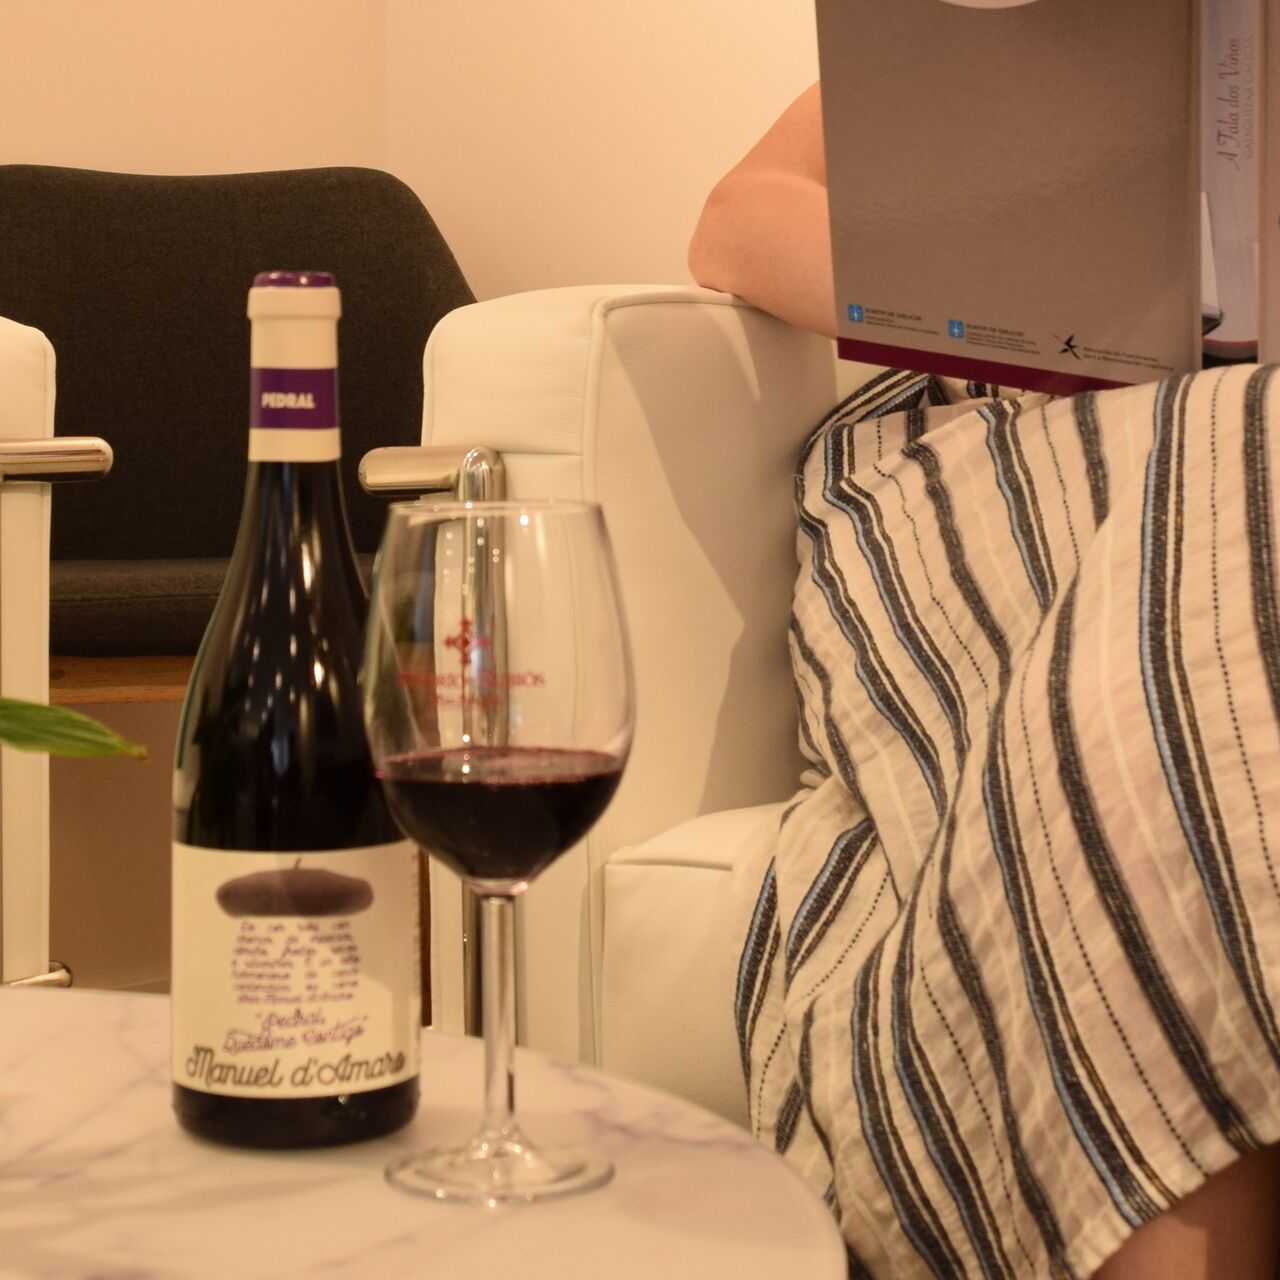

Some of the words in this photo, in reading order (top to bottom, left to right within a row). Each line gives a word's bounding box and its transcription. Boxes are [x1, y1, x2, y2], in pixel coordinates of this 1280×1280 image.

[1216, 84, 1239, 108] dos
[261, 391, 316, 410] PEDRAL
[185, 1045, 284, 1088] Manuel
